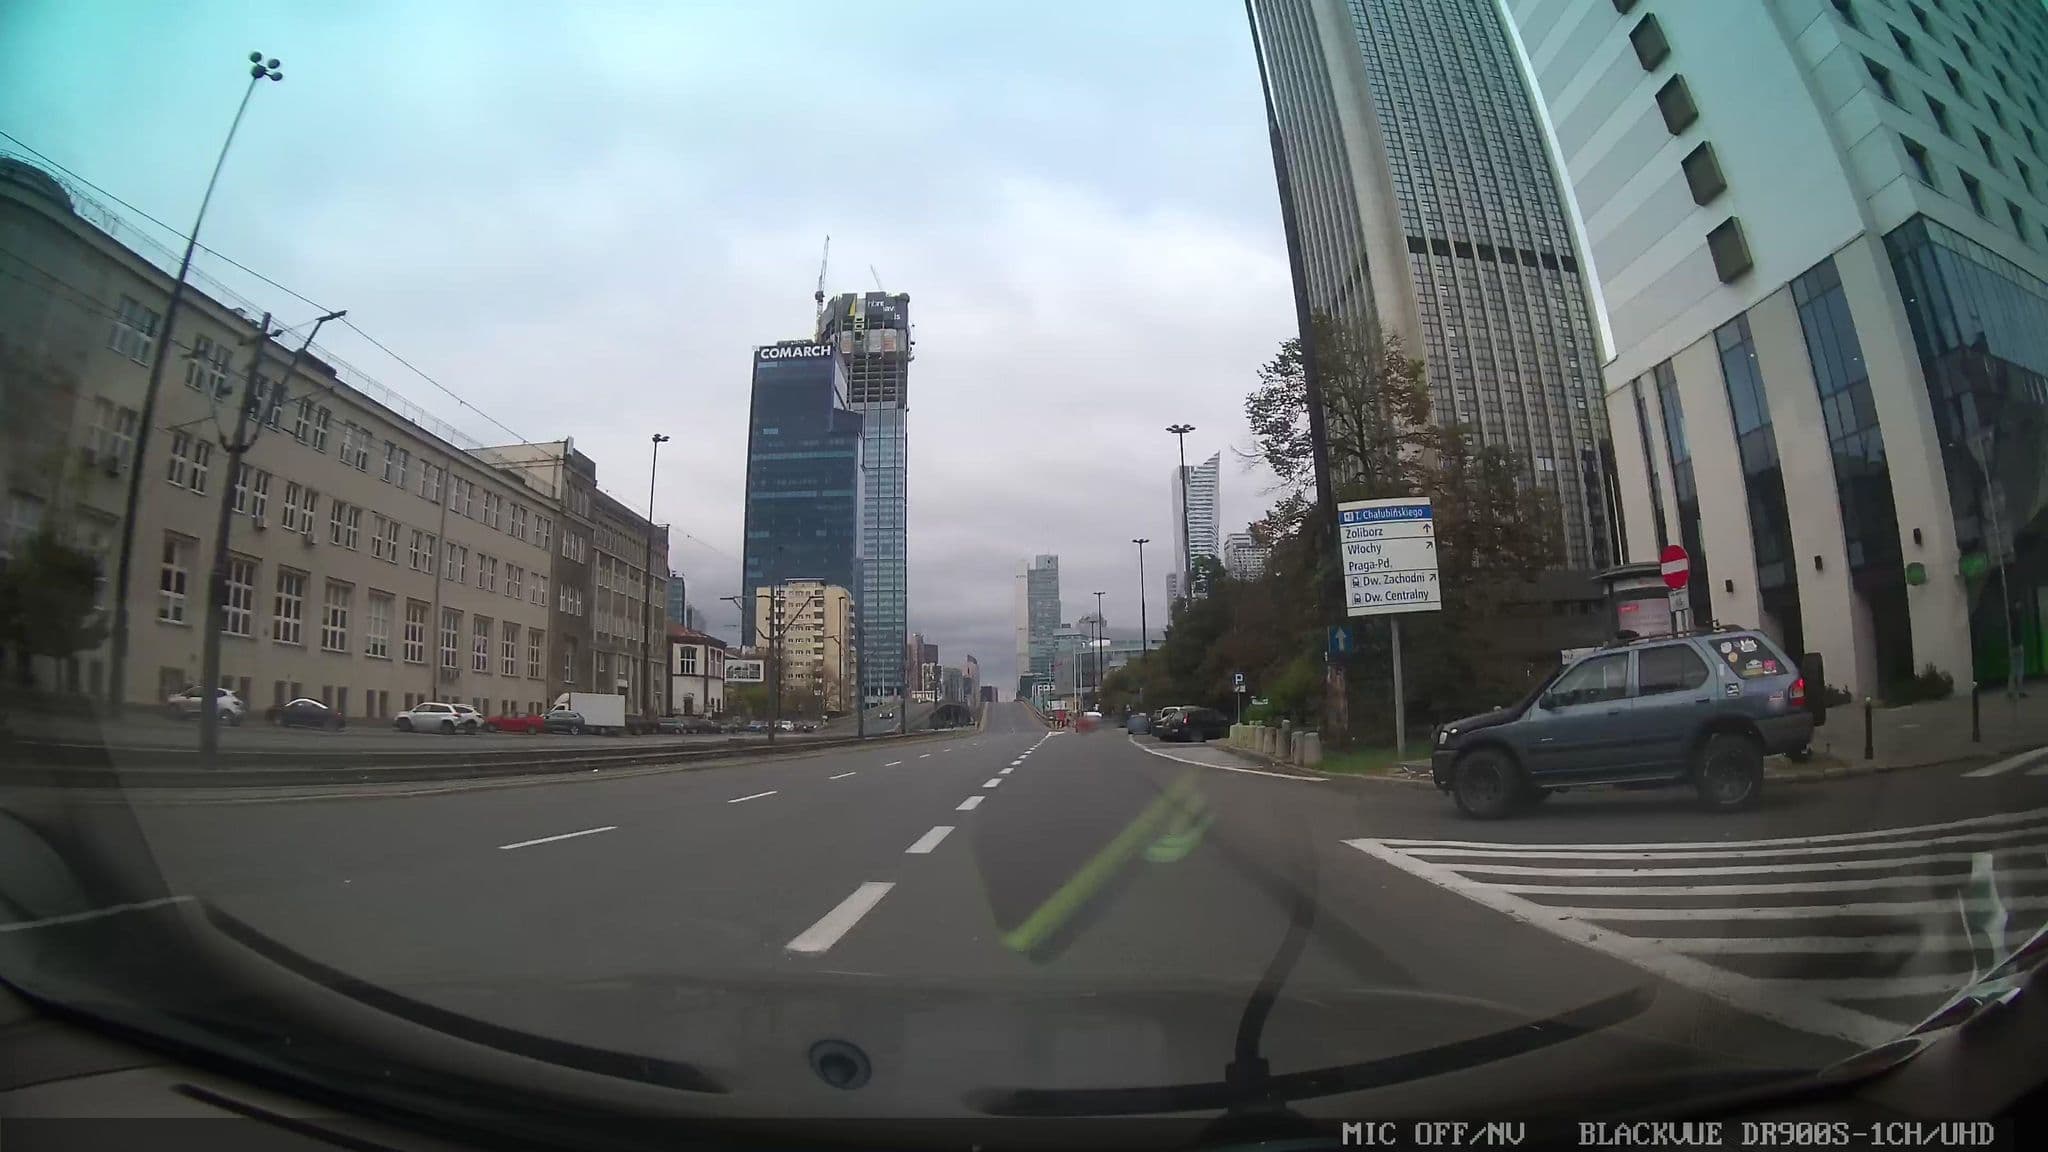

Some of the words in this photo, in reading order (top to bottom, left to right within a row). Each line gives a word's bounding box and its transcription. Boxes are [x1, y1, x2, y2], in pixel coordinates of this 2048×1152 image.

[760, 345, 831, 359] COMARCH
[1348, 558, 1393, 572] Praga-Pd.
[1363, 576, 1381, 586] Dw.
[1383, 572, 1425, 585] Zachodni
[1364, 592, 1382, 603] Dw.
[1385, 589, 1429, 601] Centralny
[1235, 673, 1243, 685] P
